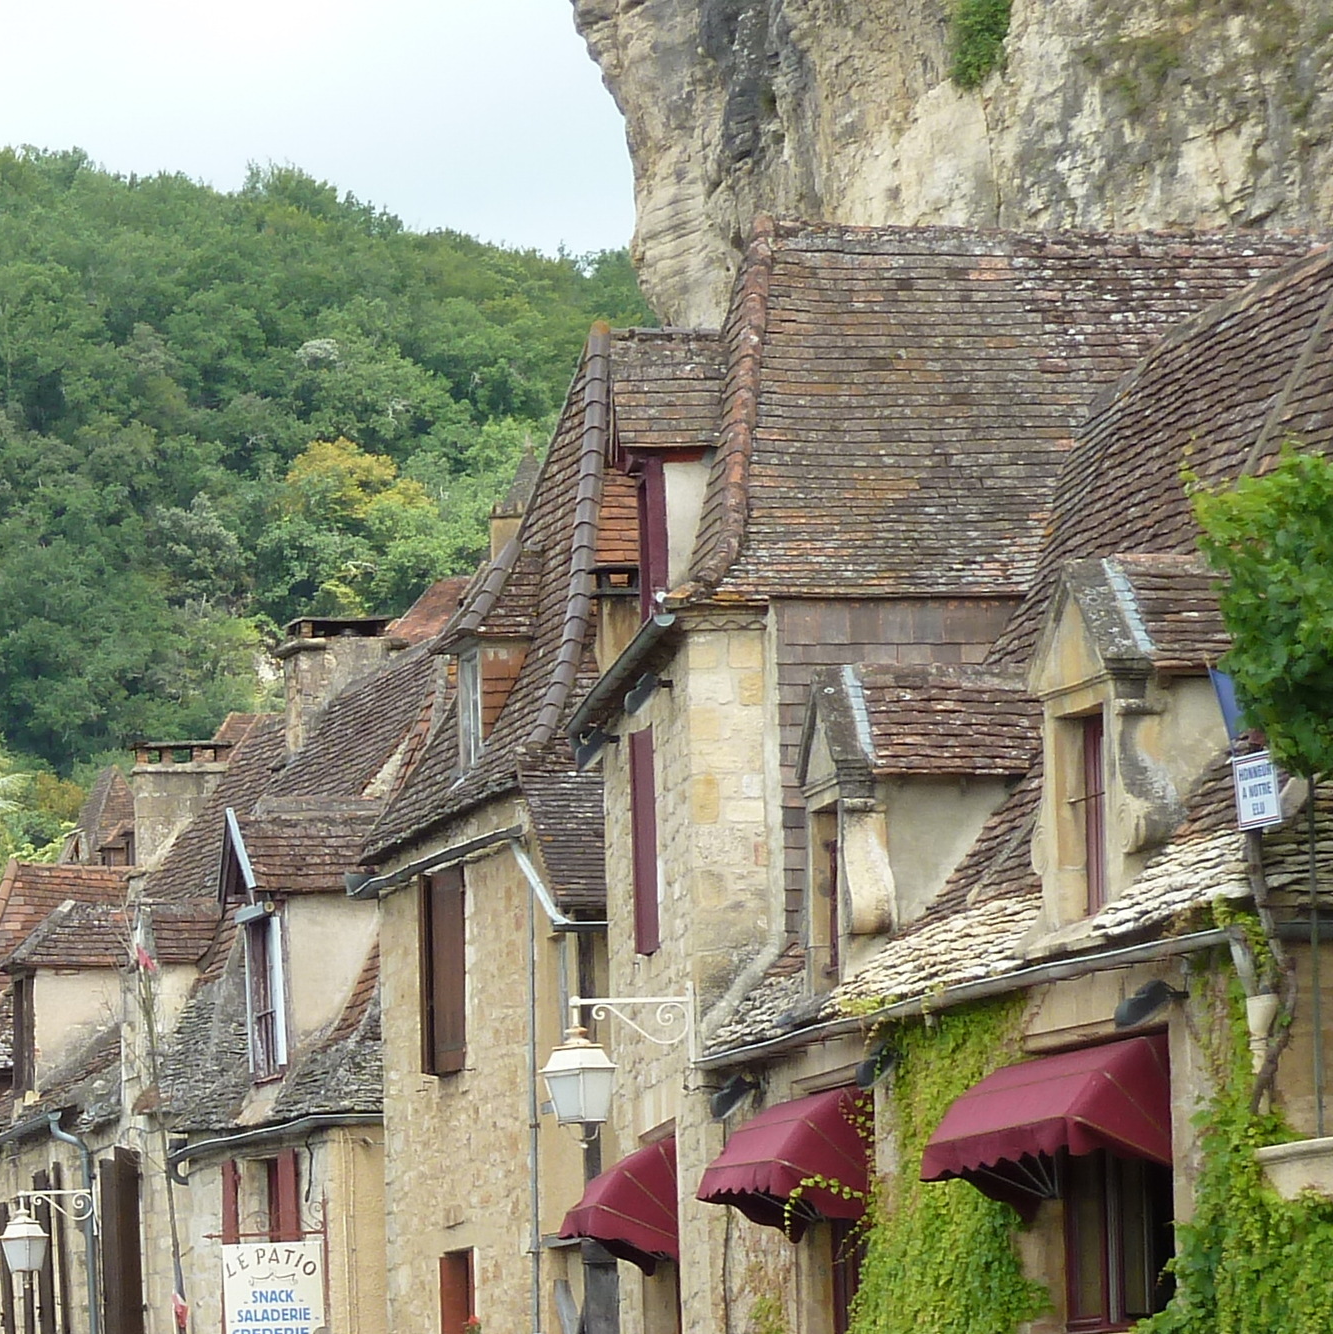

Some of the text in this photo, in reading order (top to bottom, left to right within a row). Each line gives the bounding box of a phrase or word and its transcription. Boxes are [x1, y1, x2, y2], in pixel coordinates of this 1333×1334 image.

[1248, 781, 1273, 798] NOTRE
[226, 1247, 317, 1278] LE PATIO
[251, 1289, 294, 1304] SNACK
[237, 1307, 311, 1323] SALADERIE
